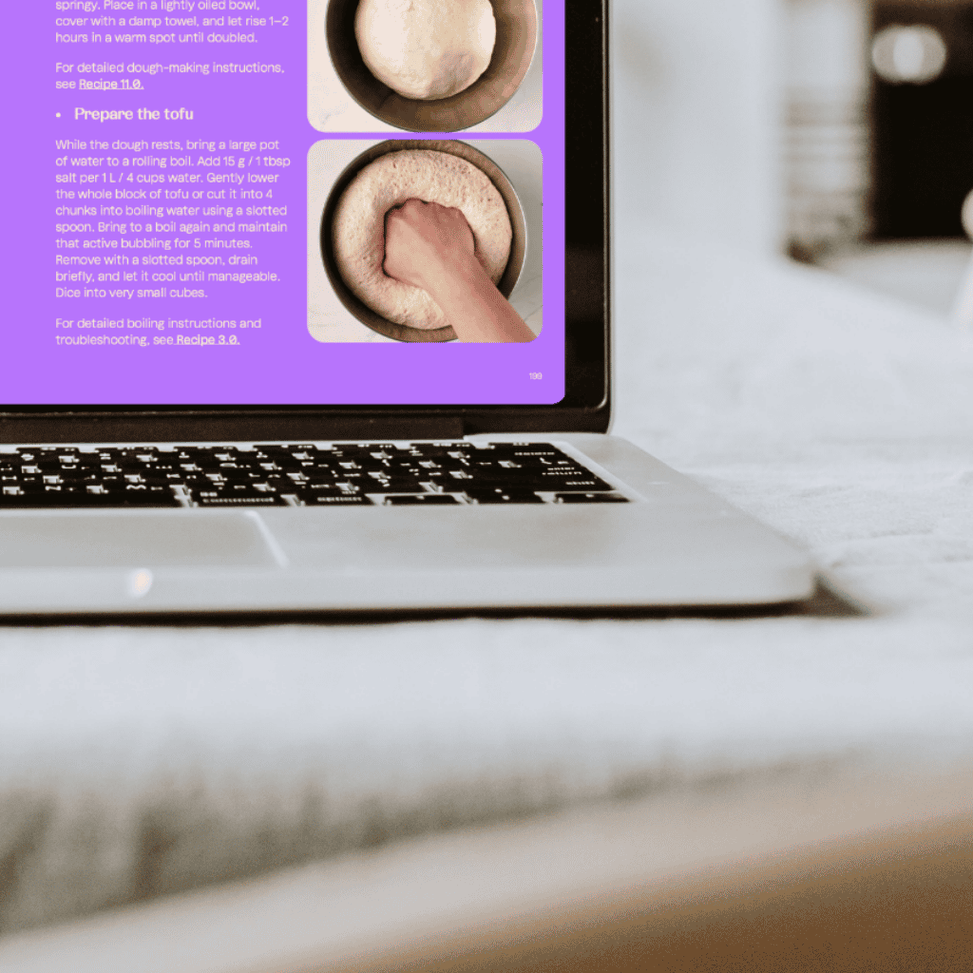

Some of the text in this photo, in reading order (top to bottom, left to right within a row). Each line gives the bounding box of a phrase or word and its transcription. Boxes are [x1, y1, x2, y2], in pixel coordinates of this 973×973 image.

[55, 32, 258, 44] hours in a warm spot until doubled.
[55, 62, 285, 75] For detailed dough-making instructions,
[55, 81, 77, 89] see
[78, 78, 118, 91] Recipe
[74, 107, 194, 123] Prepare the tofu
[55, 237, 253, 250] that active bubbling for 5 minutes.
[55, 254, 258, 266] Remove with a slotted spoon, drain
[55, 287, 208, 299] Dice into very small cubes.
[55, 317, 262, 330] For detailed boiling instructions and
[55, 334, 150, 347] troubleshooting,
[152, 336, 174, 345] see
[176, 334, 216, 346] Recipe
